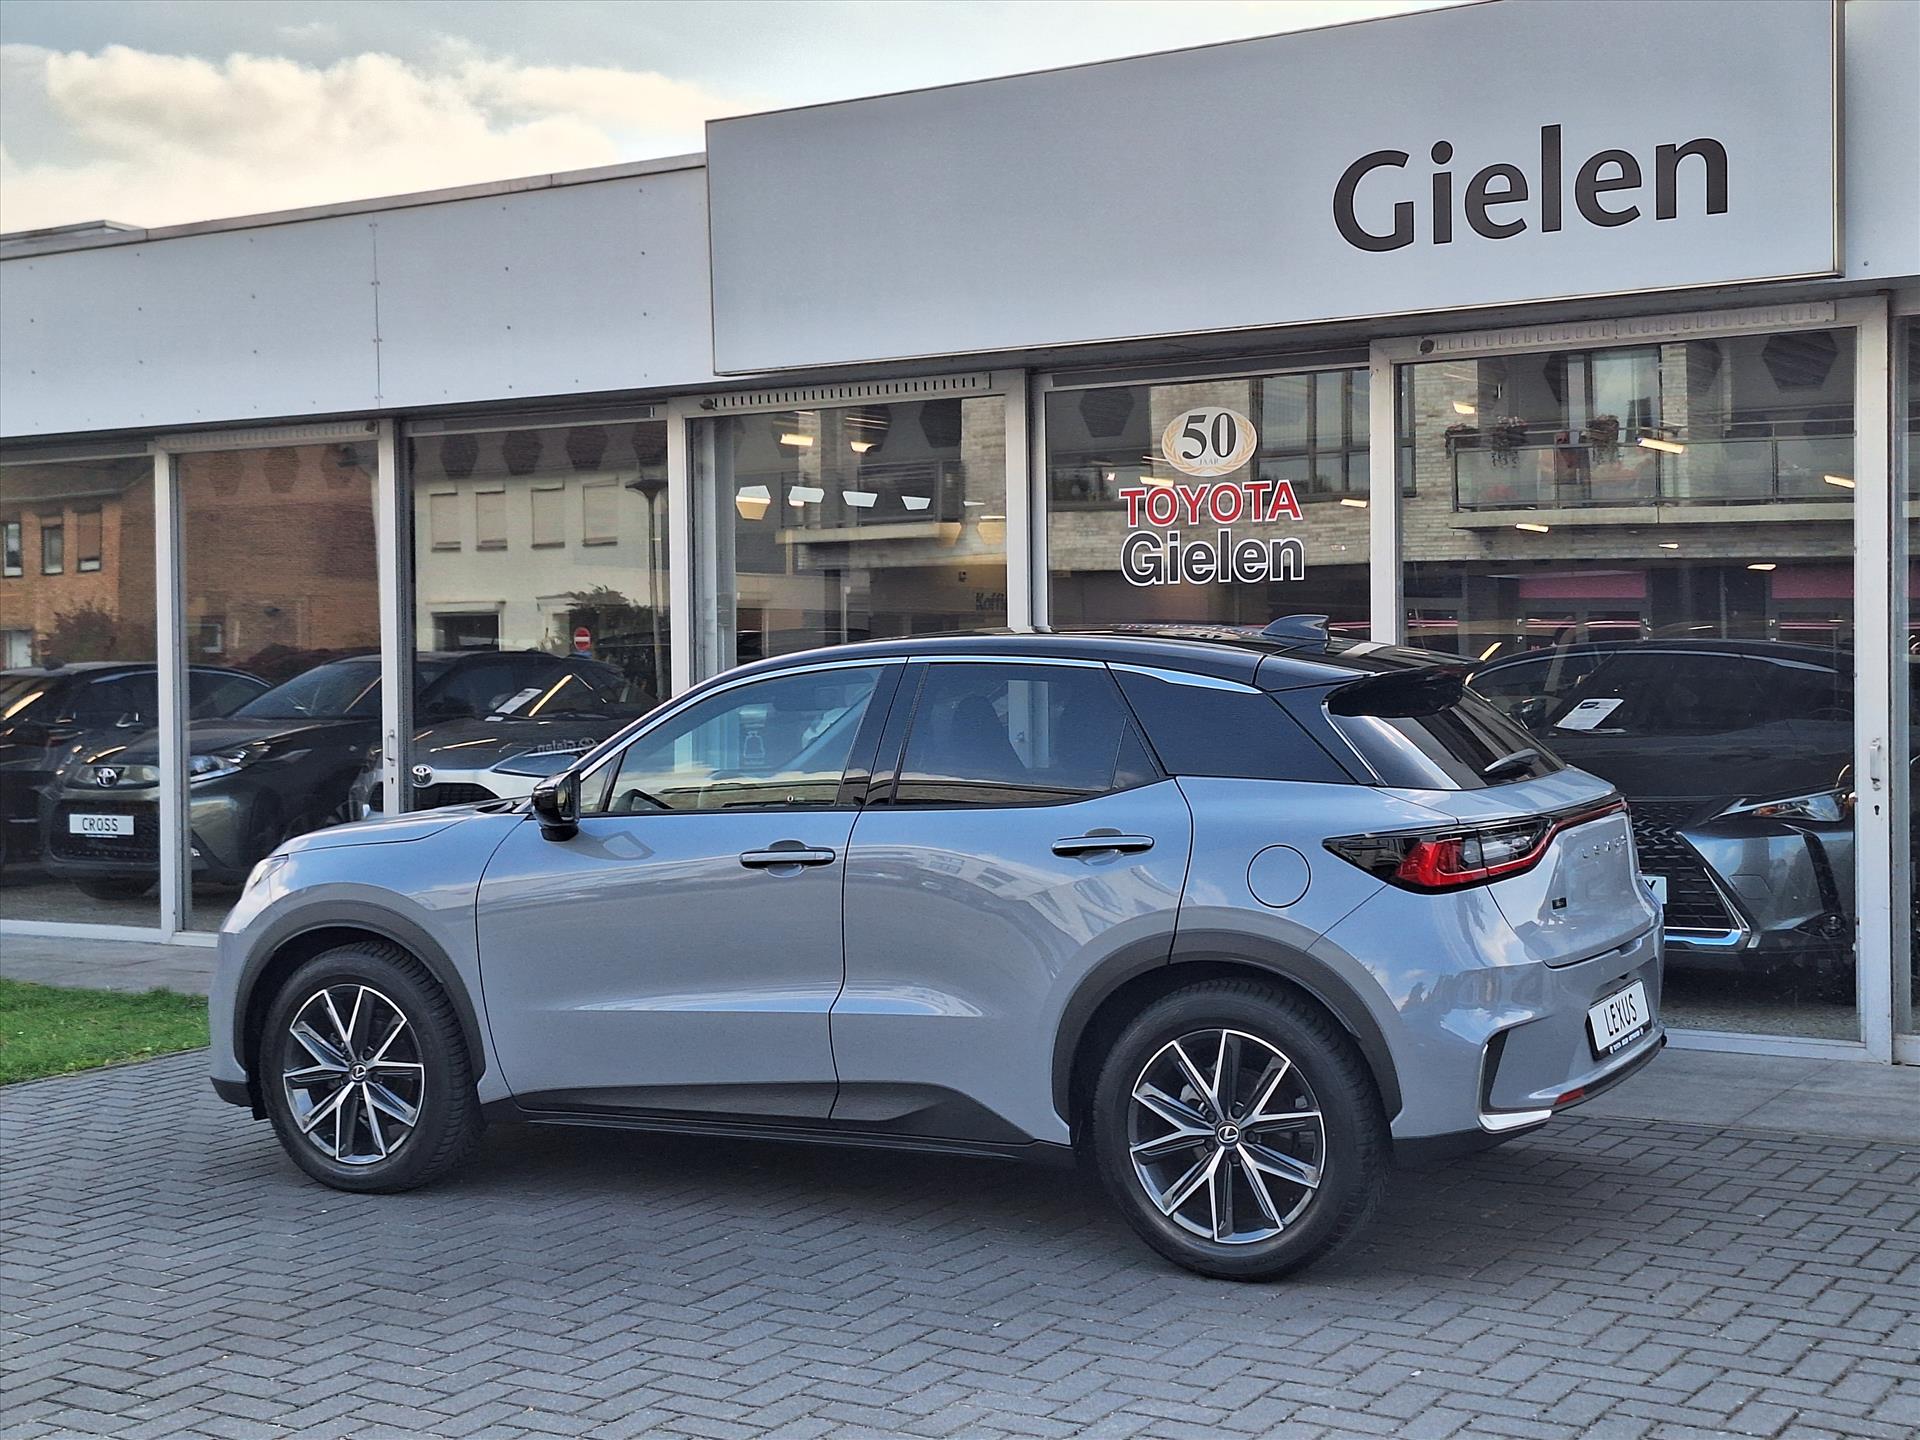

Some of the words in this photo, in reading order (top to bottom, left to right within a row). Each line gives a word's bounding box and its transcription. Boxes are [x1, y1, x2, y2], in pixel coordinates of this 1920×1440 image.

[1333, 123, 1728, 253] Gielen
[1182, 412, 1237, 460] 50
[1199, 457, 1219, 466] JAAR
[1119, 479, 1304, 528] TOYOTA
[1120, 528, 1305, 587] Gielen
[82, 817, 119, 832] CROSS
[1603, 993, 1638, 1037] LEXUS
